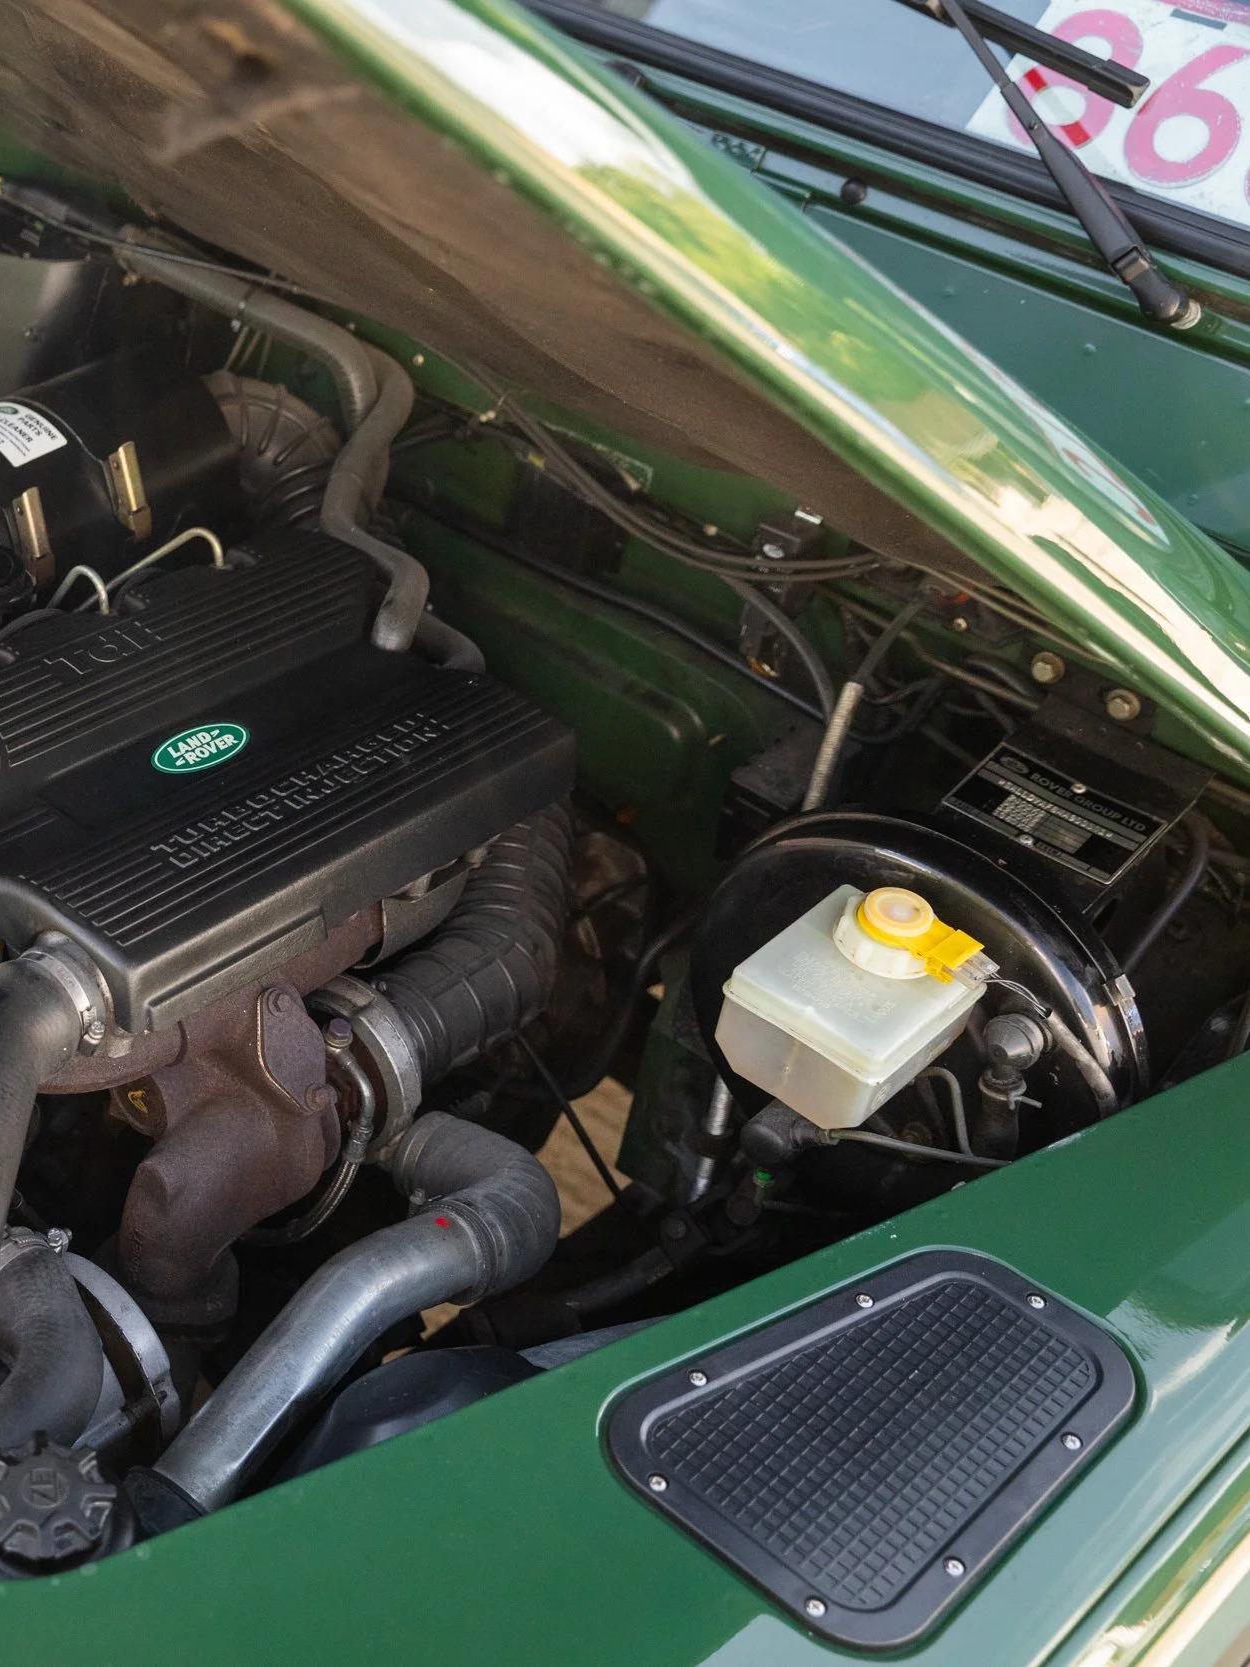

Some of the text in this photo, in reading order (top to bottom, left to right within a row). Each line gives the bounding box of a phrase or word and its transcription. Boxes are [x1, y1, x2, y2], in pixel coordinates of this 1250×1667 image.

[1007, 9, 1250, 206] 86
[150, 714, 420, 853] TURBOCHARGED
[169, 727, 439, 869] DIRECT INJECTION
[186, 734, 239, 766] ROVER
[1030, 772, 1073, 799] ROVER
[1075, 795, 1121, 824] GROUP
